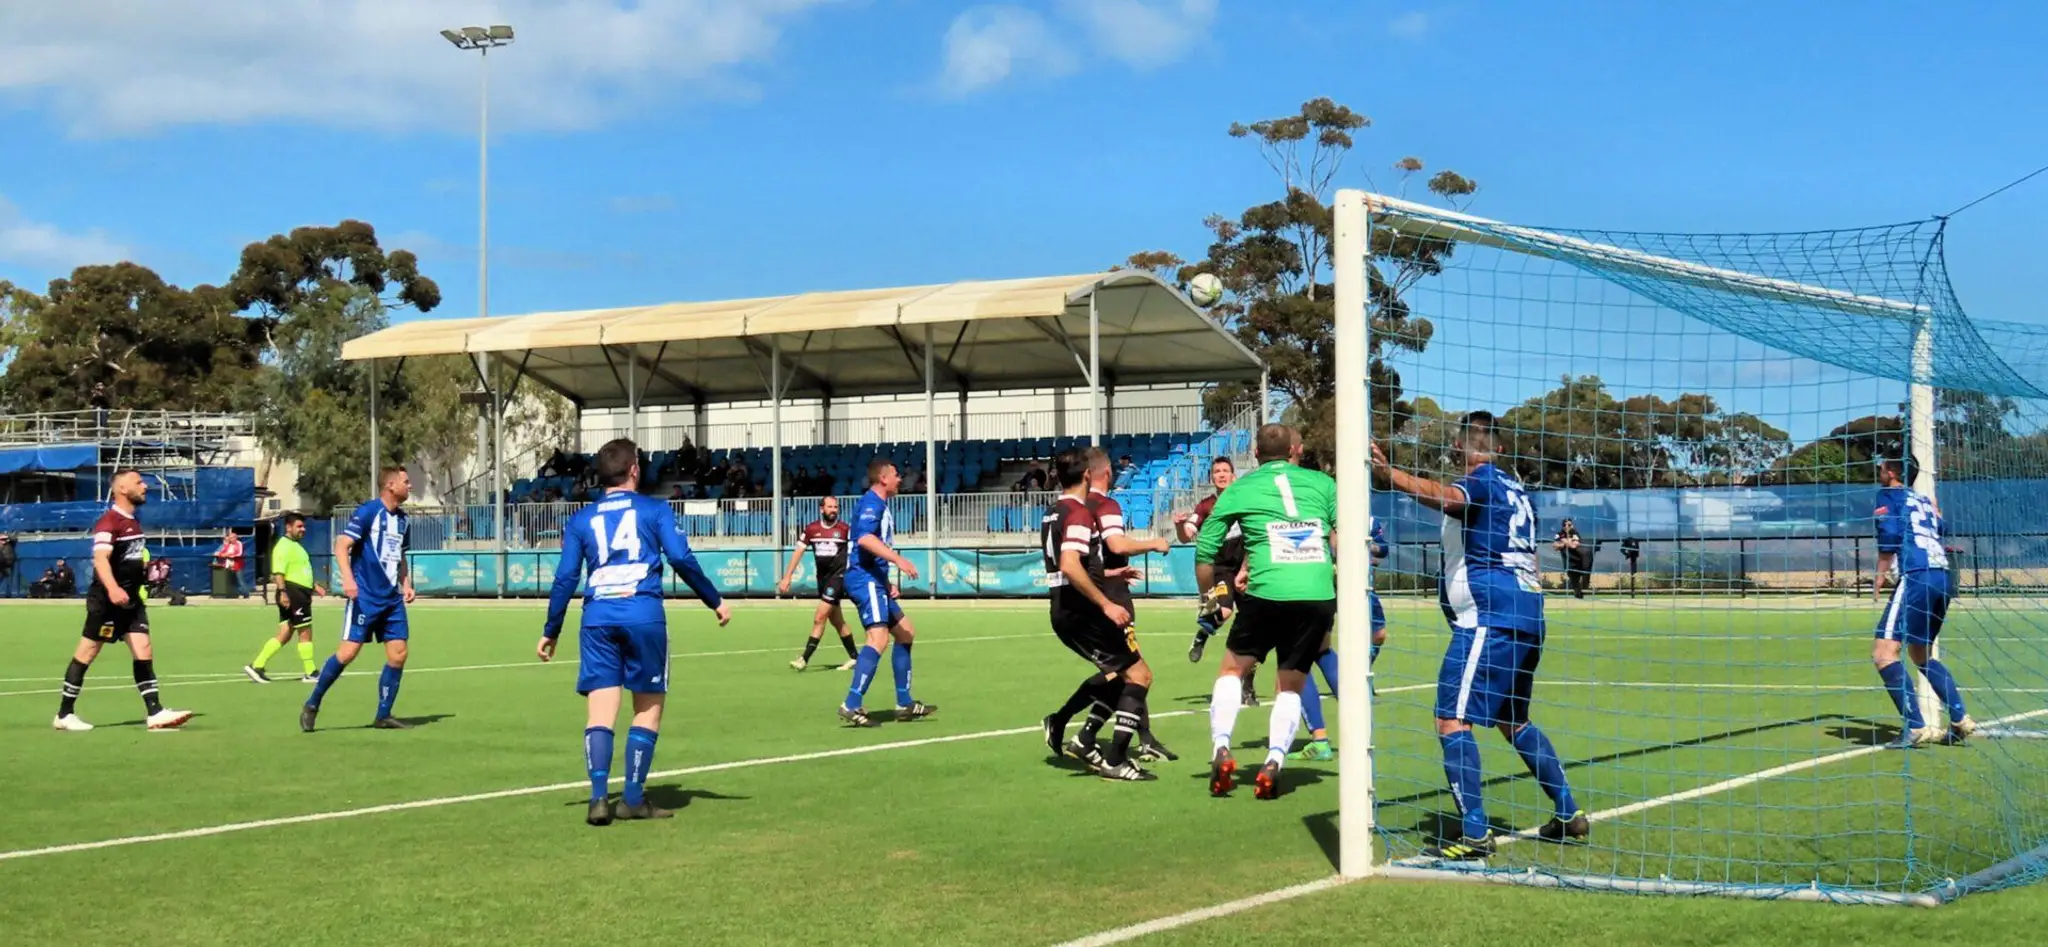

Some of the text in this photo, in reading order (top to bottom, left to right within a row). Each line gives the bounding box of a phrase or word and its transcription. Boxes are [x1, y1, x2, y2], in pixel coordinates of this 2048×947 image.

[1274, 473, 1299, 518] 1
[1506, 489, 1535, 551] 21
[590, 509, 641, 565] 14
[357, 614, 367, 625] 6
